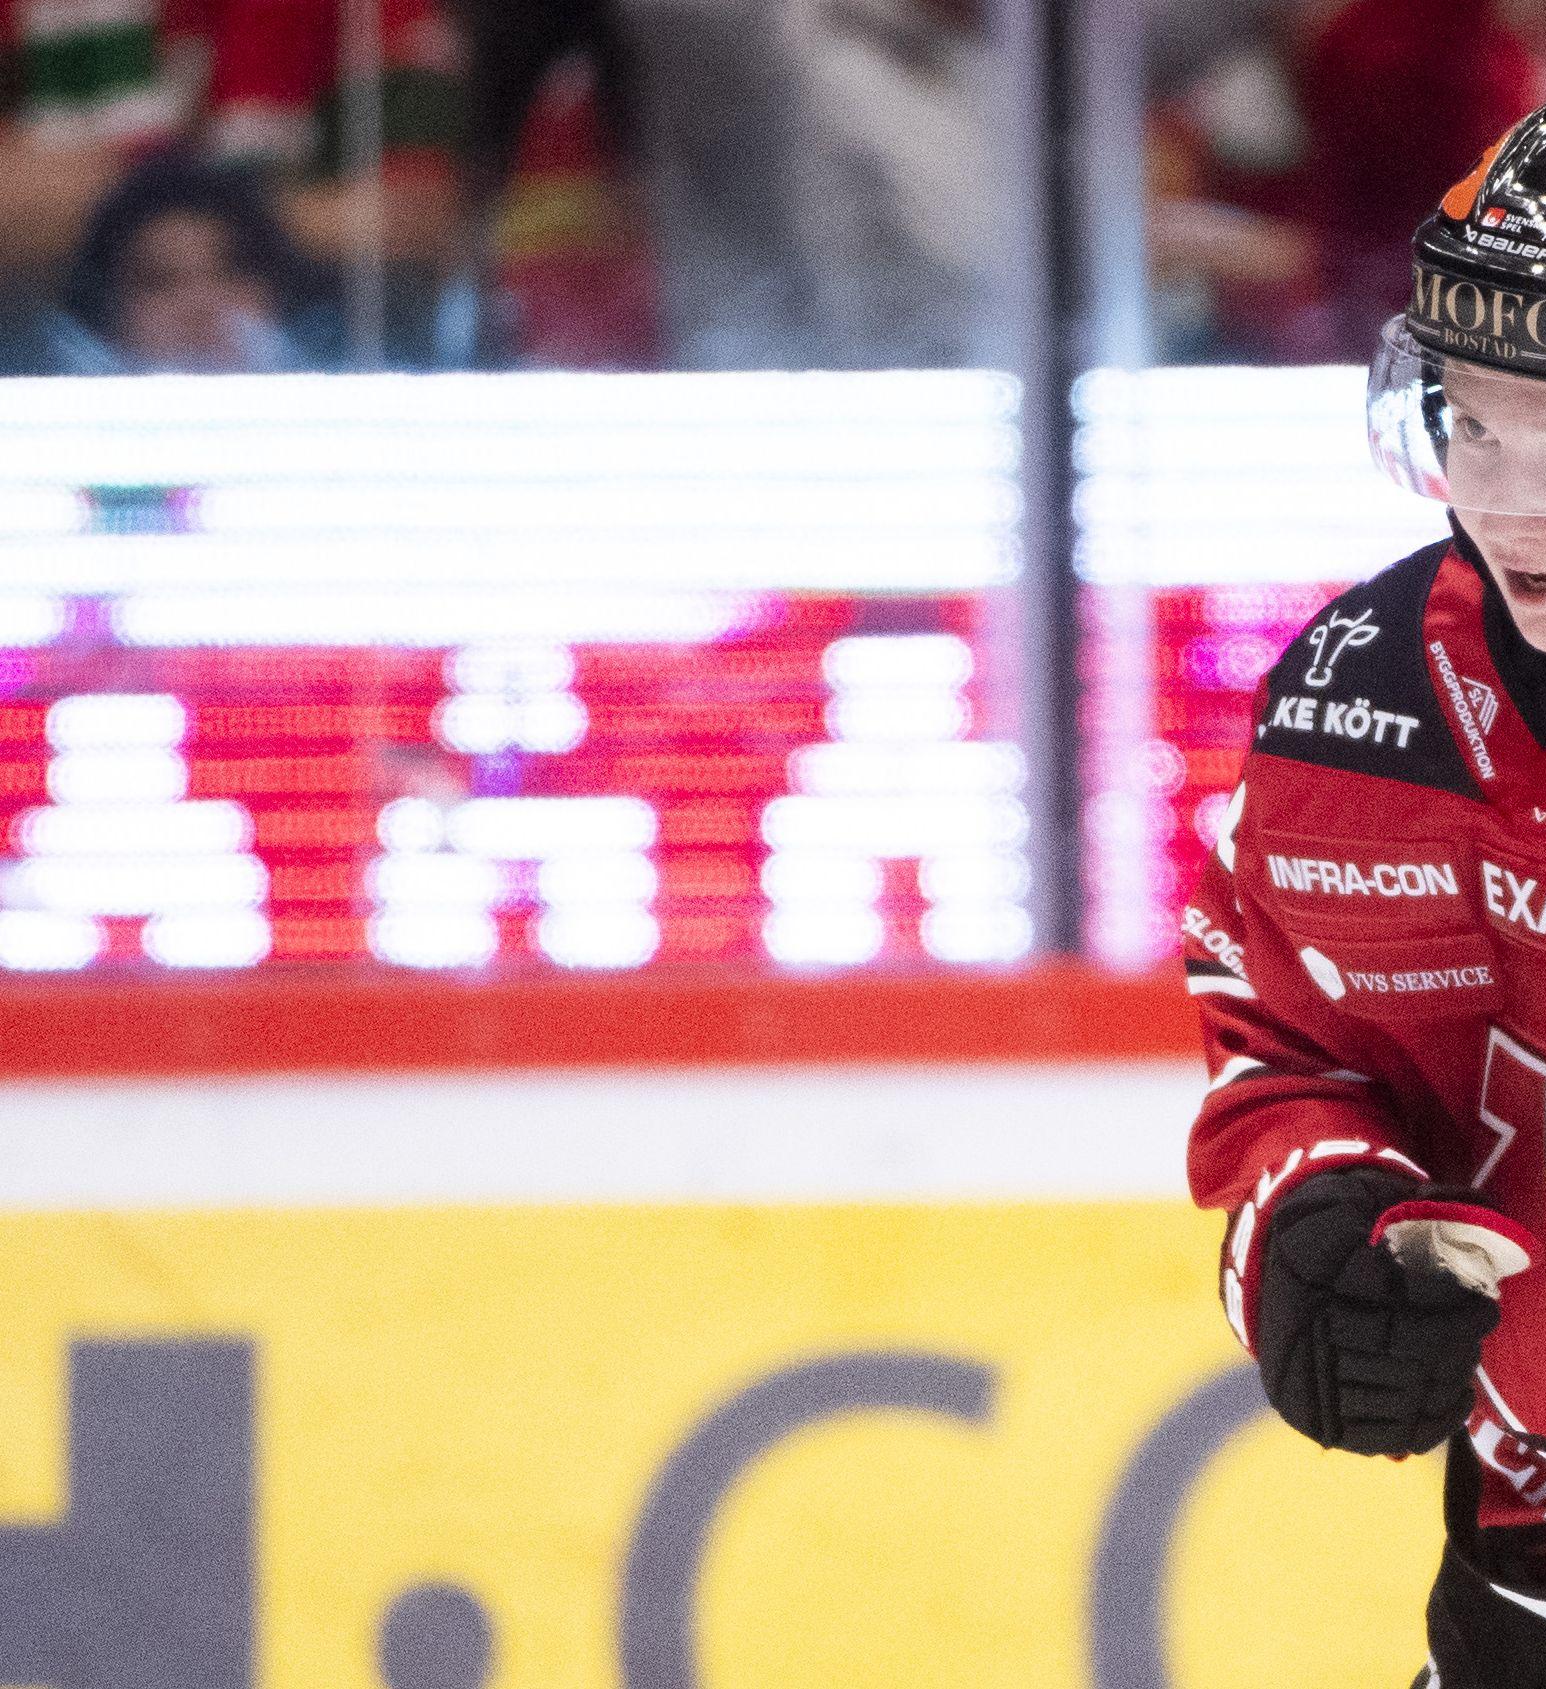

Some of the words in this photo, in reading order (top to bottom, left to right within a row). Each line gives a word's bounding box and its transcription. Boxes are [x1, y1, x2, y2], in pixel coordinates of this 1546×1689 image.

[1323, 698, 1419, 749] KÖTT
[1429, 641, 1496, 780] BYGGPRODUKTION
[1267, 854, 1459, 898] INFRA-CON
[1347, 971, 1388, 993] VVS
[1392, 966, 1495, 993] SERVICE
